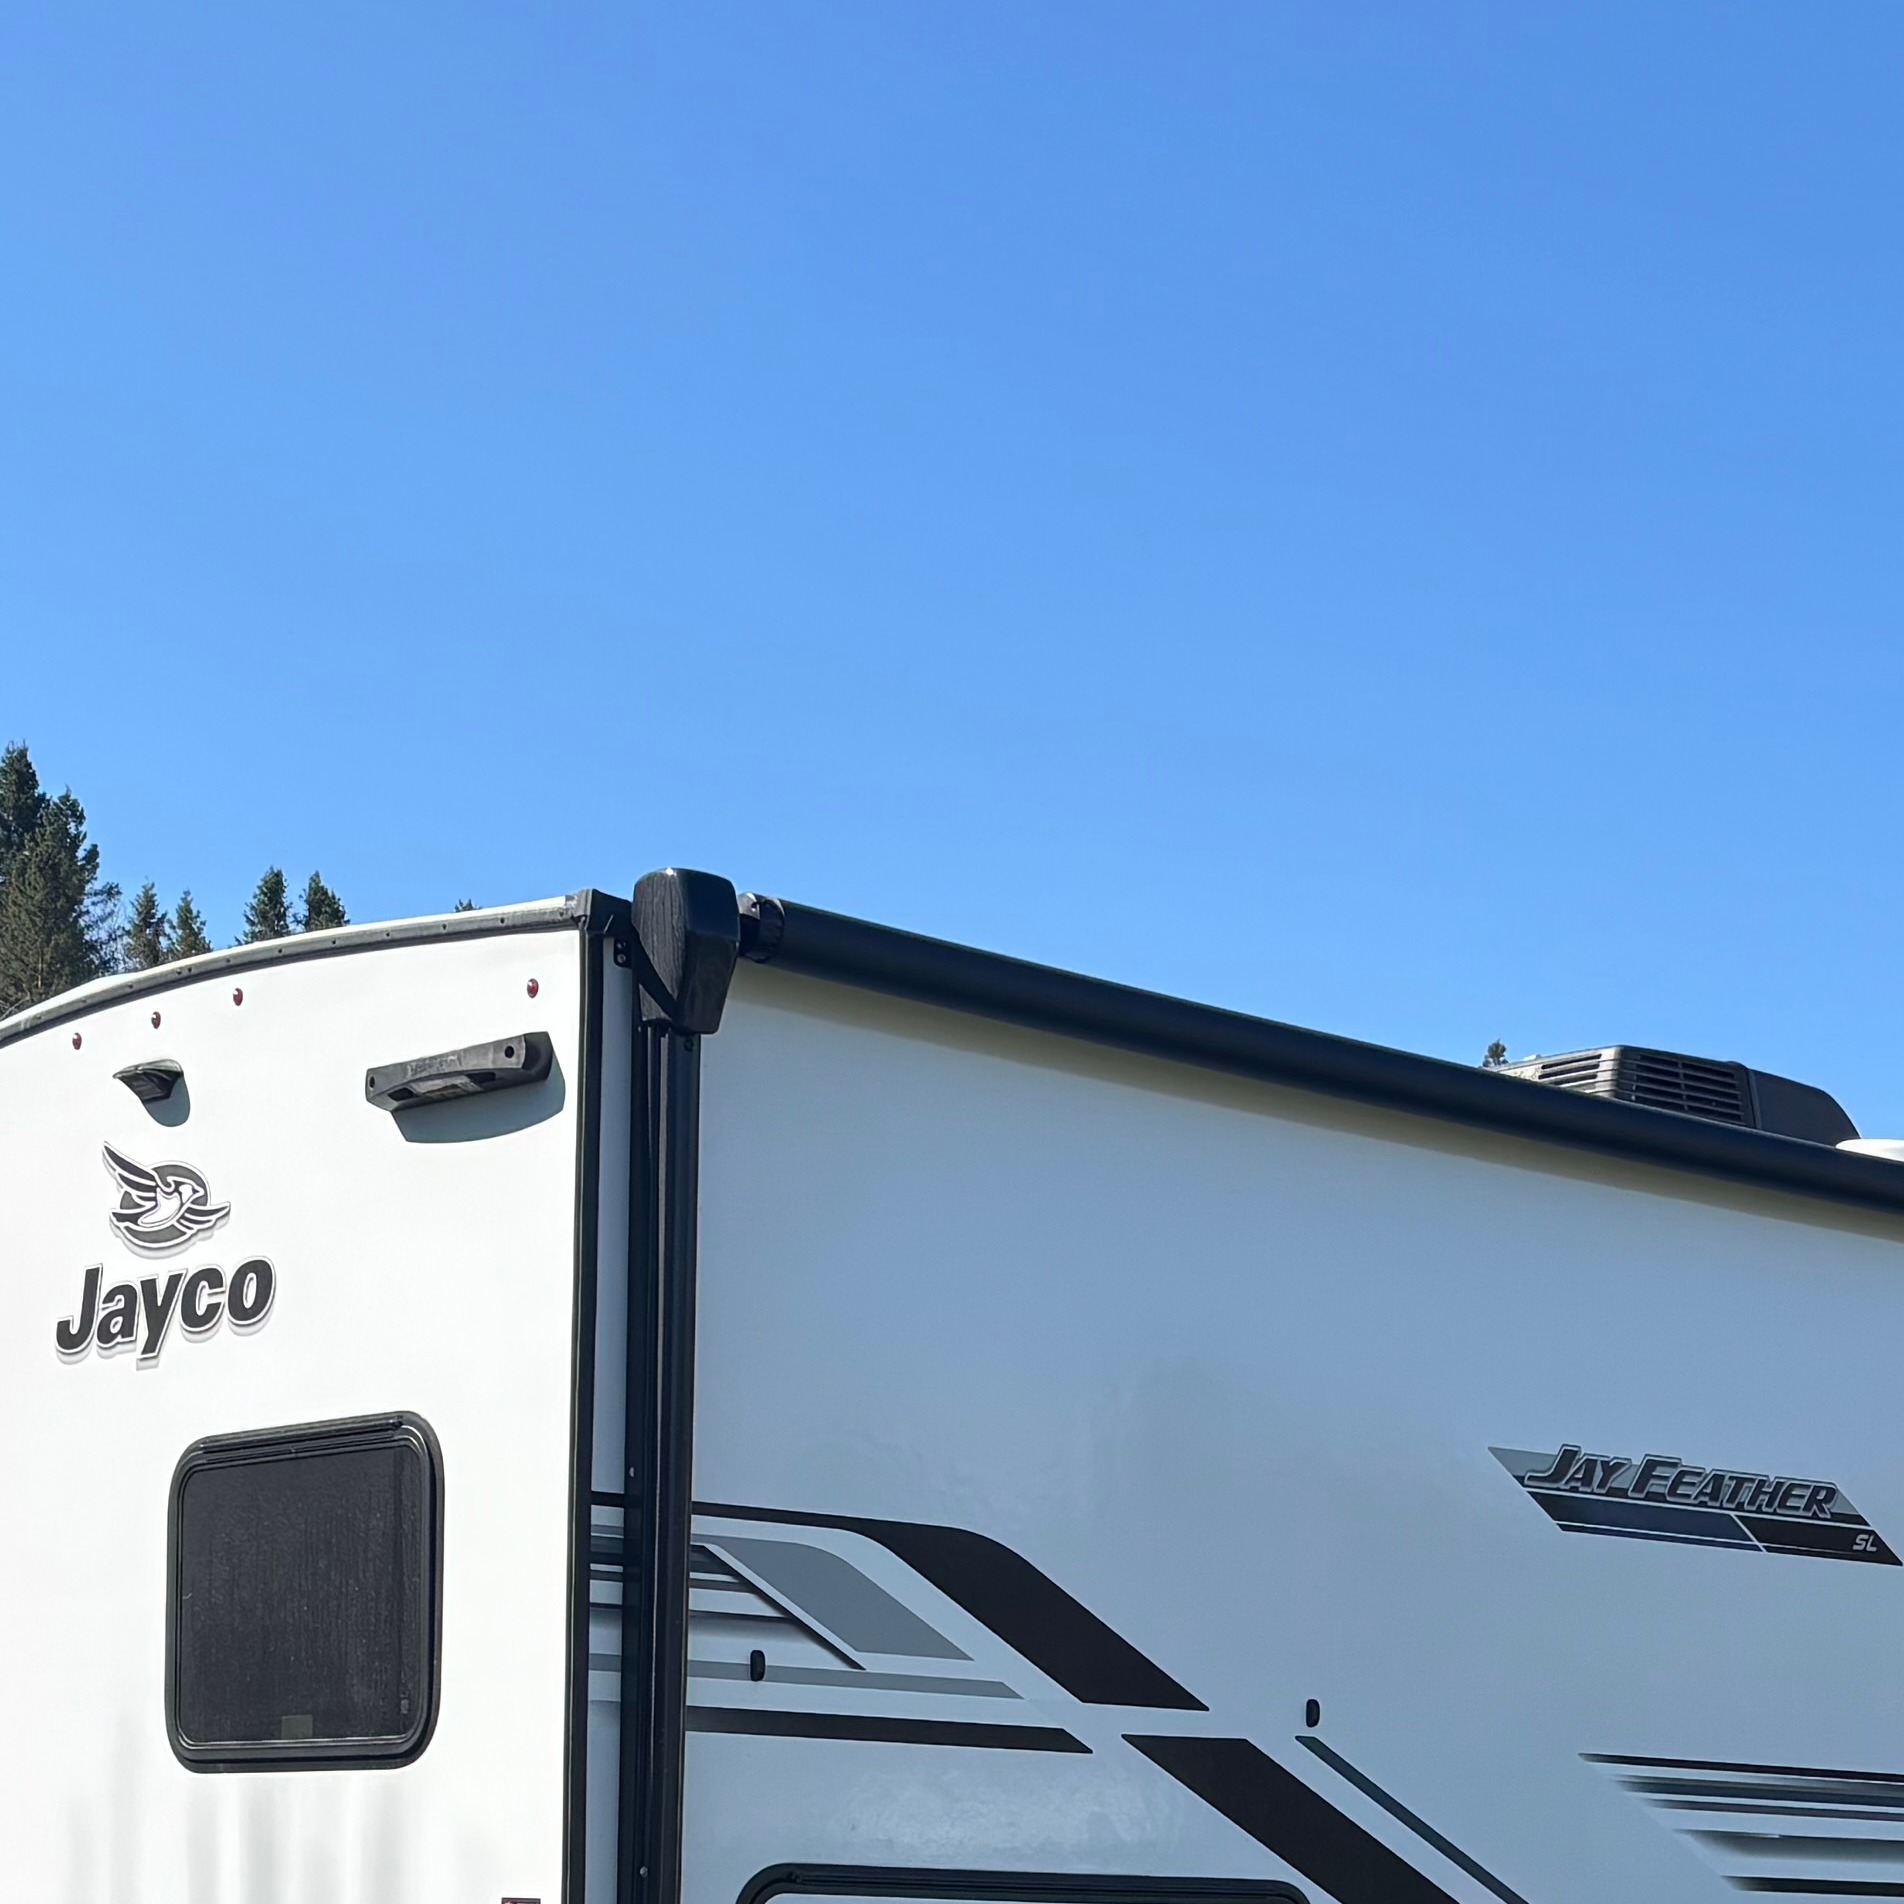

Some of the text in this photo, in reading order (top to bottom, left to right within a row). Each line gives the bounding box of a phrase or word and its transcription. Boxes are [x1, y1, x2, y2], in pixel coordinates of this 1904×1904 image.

[56, 1256, 275, 1359] Jayco
[1524, 1444, 1837, 1519] JAY FEATHER
[1852, 1534, 1878, 1552] SL
